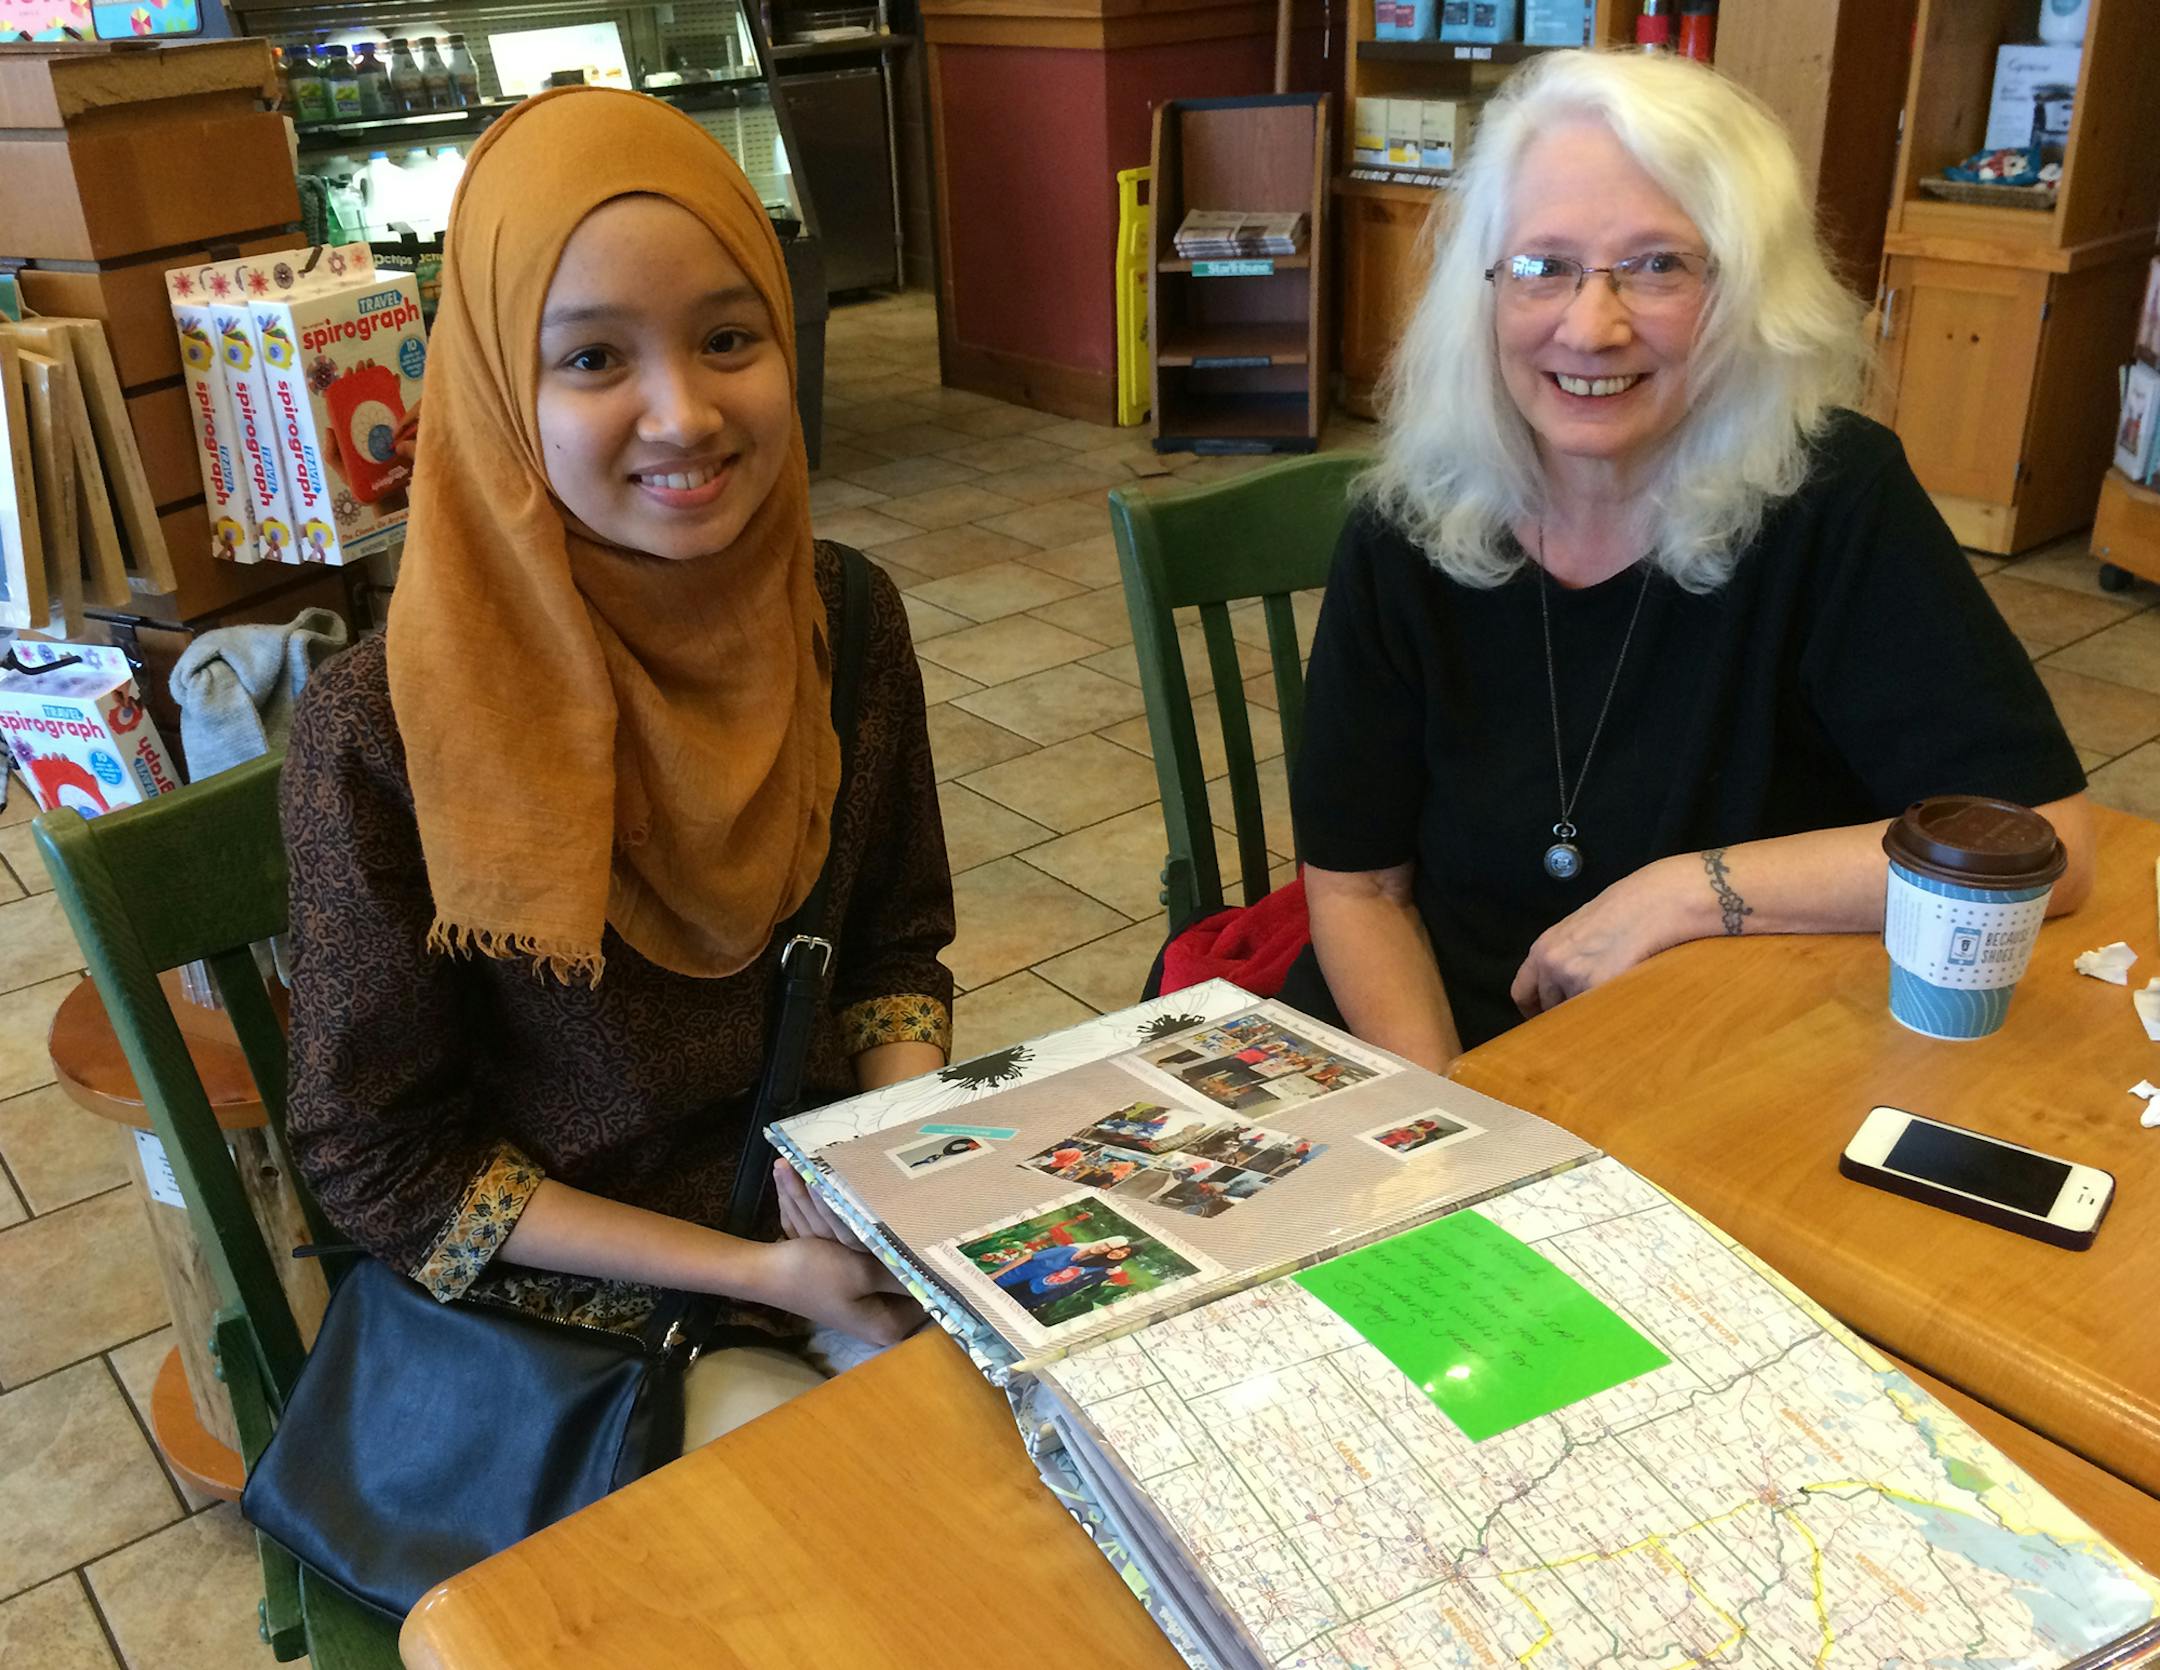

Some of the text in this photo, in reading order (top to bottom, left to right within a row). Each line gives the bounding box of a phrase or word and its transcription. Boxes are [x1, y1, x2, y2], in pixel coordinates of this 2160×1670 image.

[303, 297, 419, 353] spirograph
[359, 290, 400, 313] TRAVEL
[196, 382, 229, 505] spirograph
[236, 382, 274, 506] spirograph
[278, 380, 317, 507] spirograph
[0, 711, 106, 741] spirograph
[1700, 1309, 1739, 1345] DAKOTA
[1334, 1440, 1372, 1481] KANSAS
[1644, 1546, 1672, 1576] IOWA
[1855, 1552, 1929, 1614] WISCONSIN
[1442, 1607, 1497, 1666] MISSOURI
